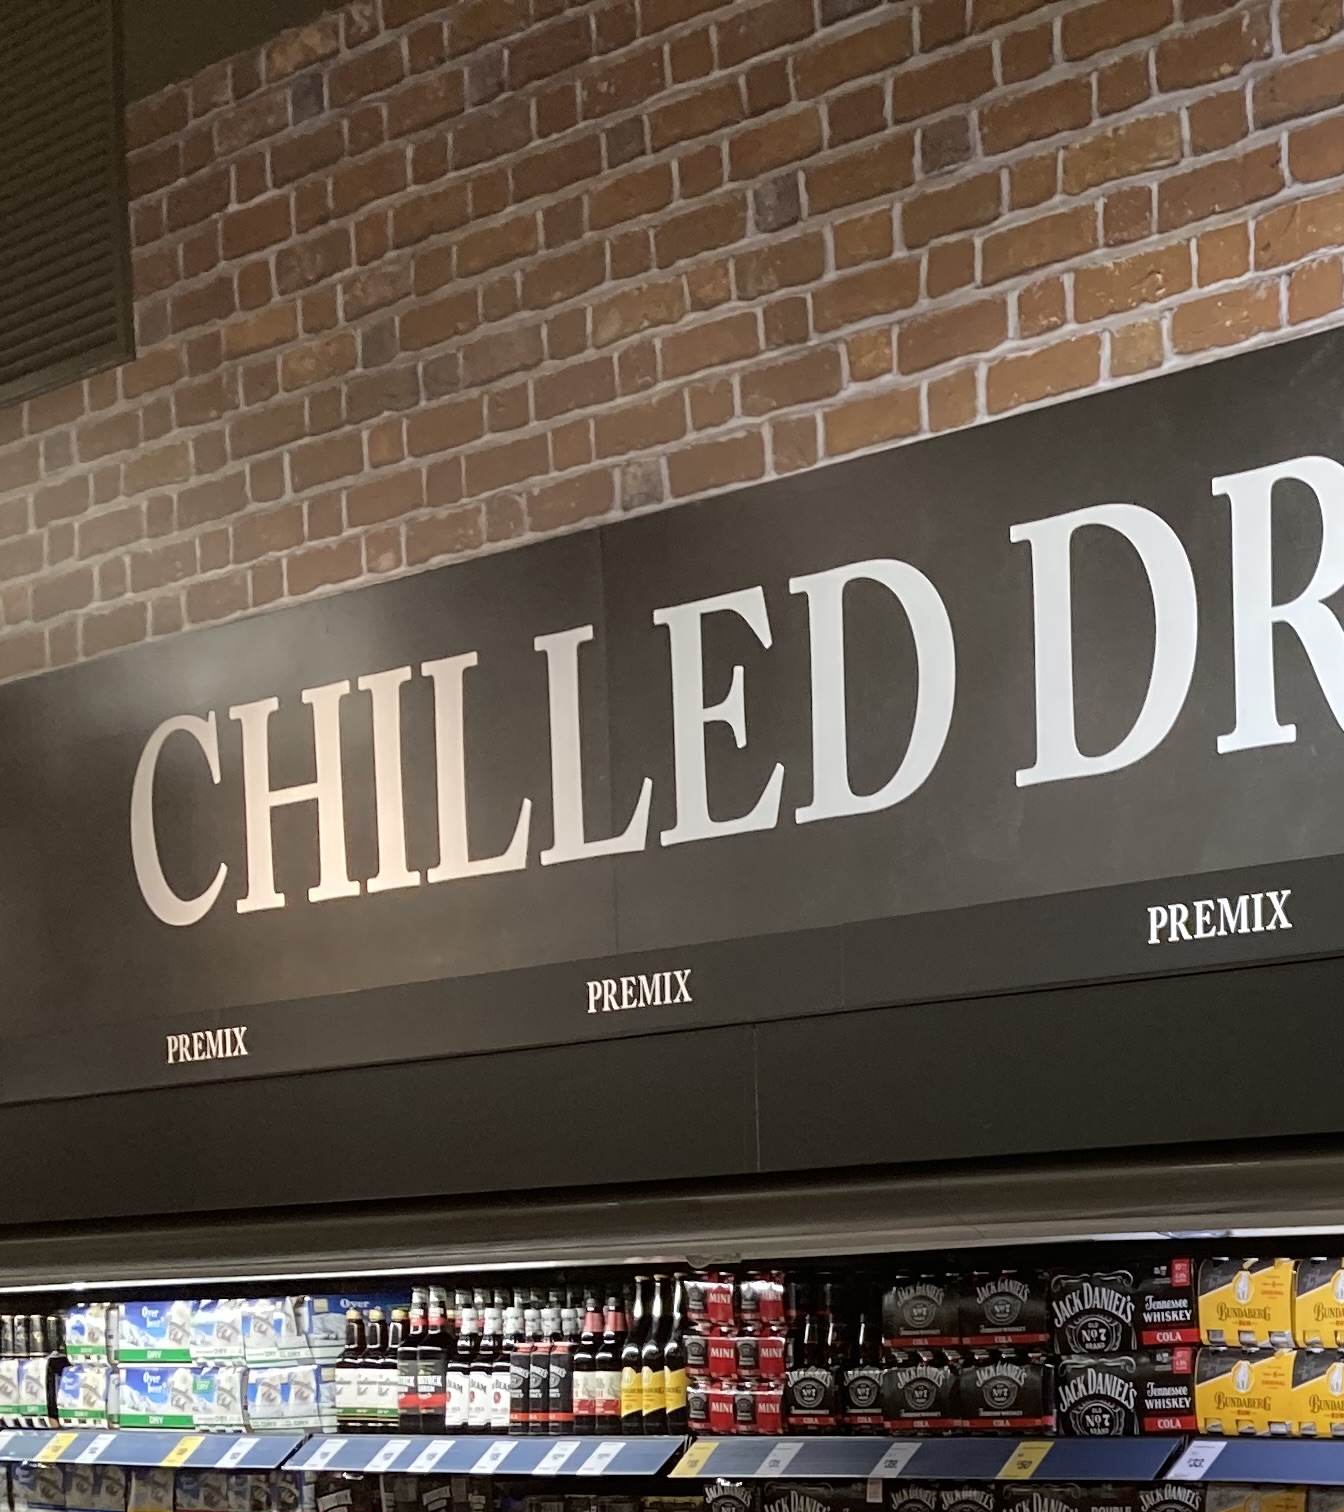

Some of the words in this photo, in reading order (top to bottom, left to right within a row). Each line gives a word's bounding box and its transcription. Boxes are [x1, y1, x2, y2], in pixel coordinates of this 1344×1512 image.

[129, 556, 956, 926] CHILLED
[1146, 888, 1294, 945] PREMIX
[586, 967, 692, 1014] PREMIX
[166, 1027, 248, 1063] PREMIX
[1051, 1289, 1084, 1328] JACK
[1083, 1282, 1135, 1327] DANIEL'S
[1143, 1310, 1192, 1322] WHISKEY
[710, 1349, 735, 1359] MINI
[1157, 1332, 1182, 1341] COLA
